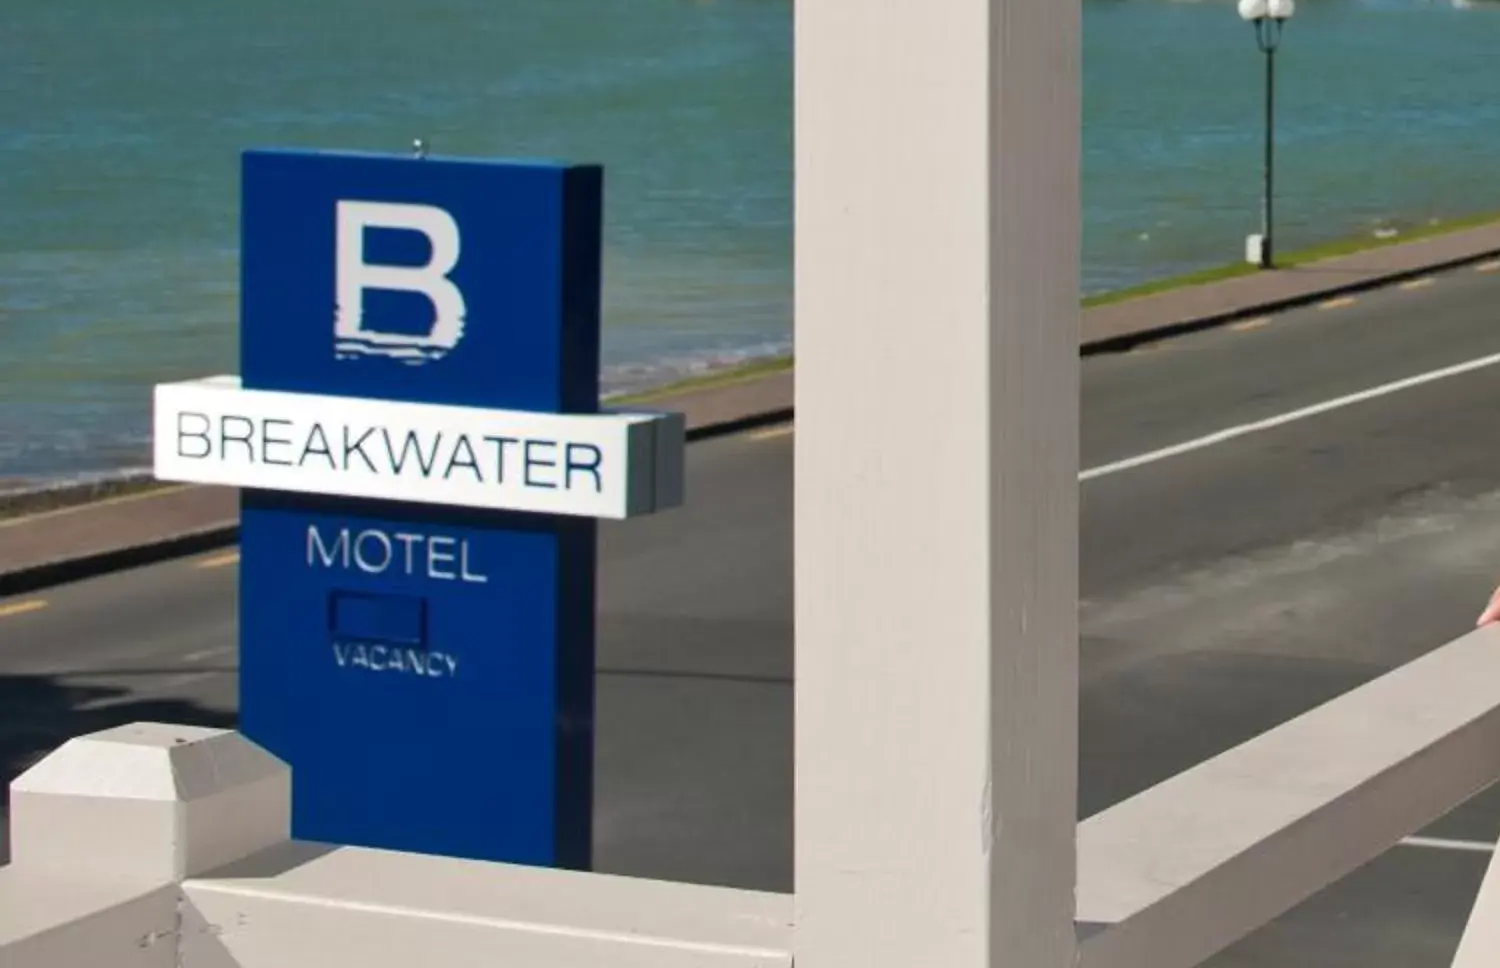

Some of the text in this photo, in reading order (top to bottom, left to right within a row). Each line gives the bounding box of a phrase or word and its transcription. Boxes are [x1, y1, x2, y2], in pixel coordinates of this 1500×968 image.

[334, 199, 467, 365] B
[176, 411, 603, 493] BREAKWATER
[306, 525, 488, 582] MOTEL
[332, 643, 459, 677] VACANCY
